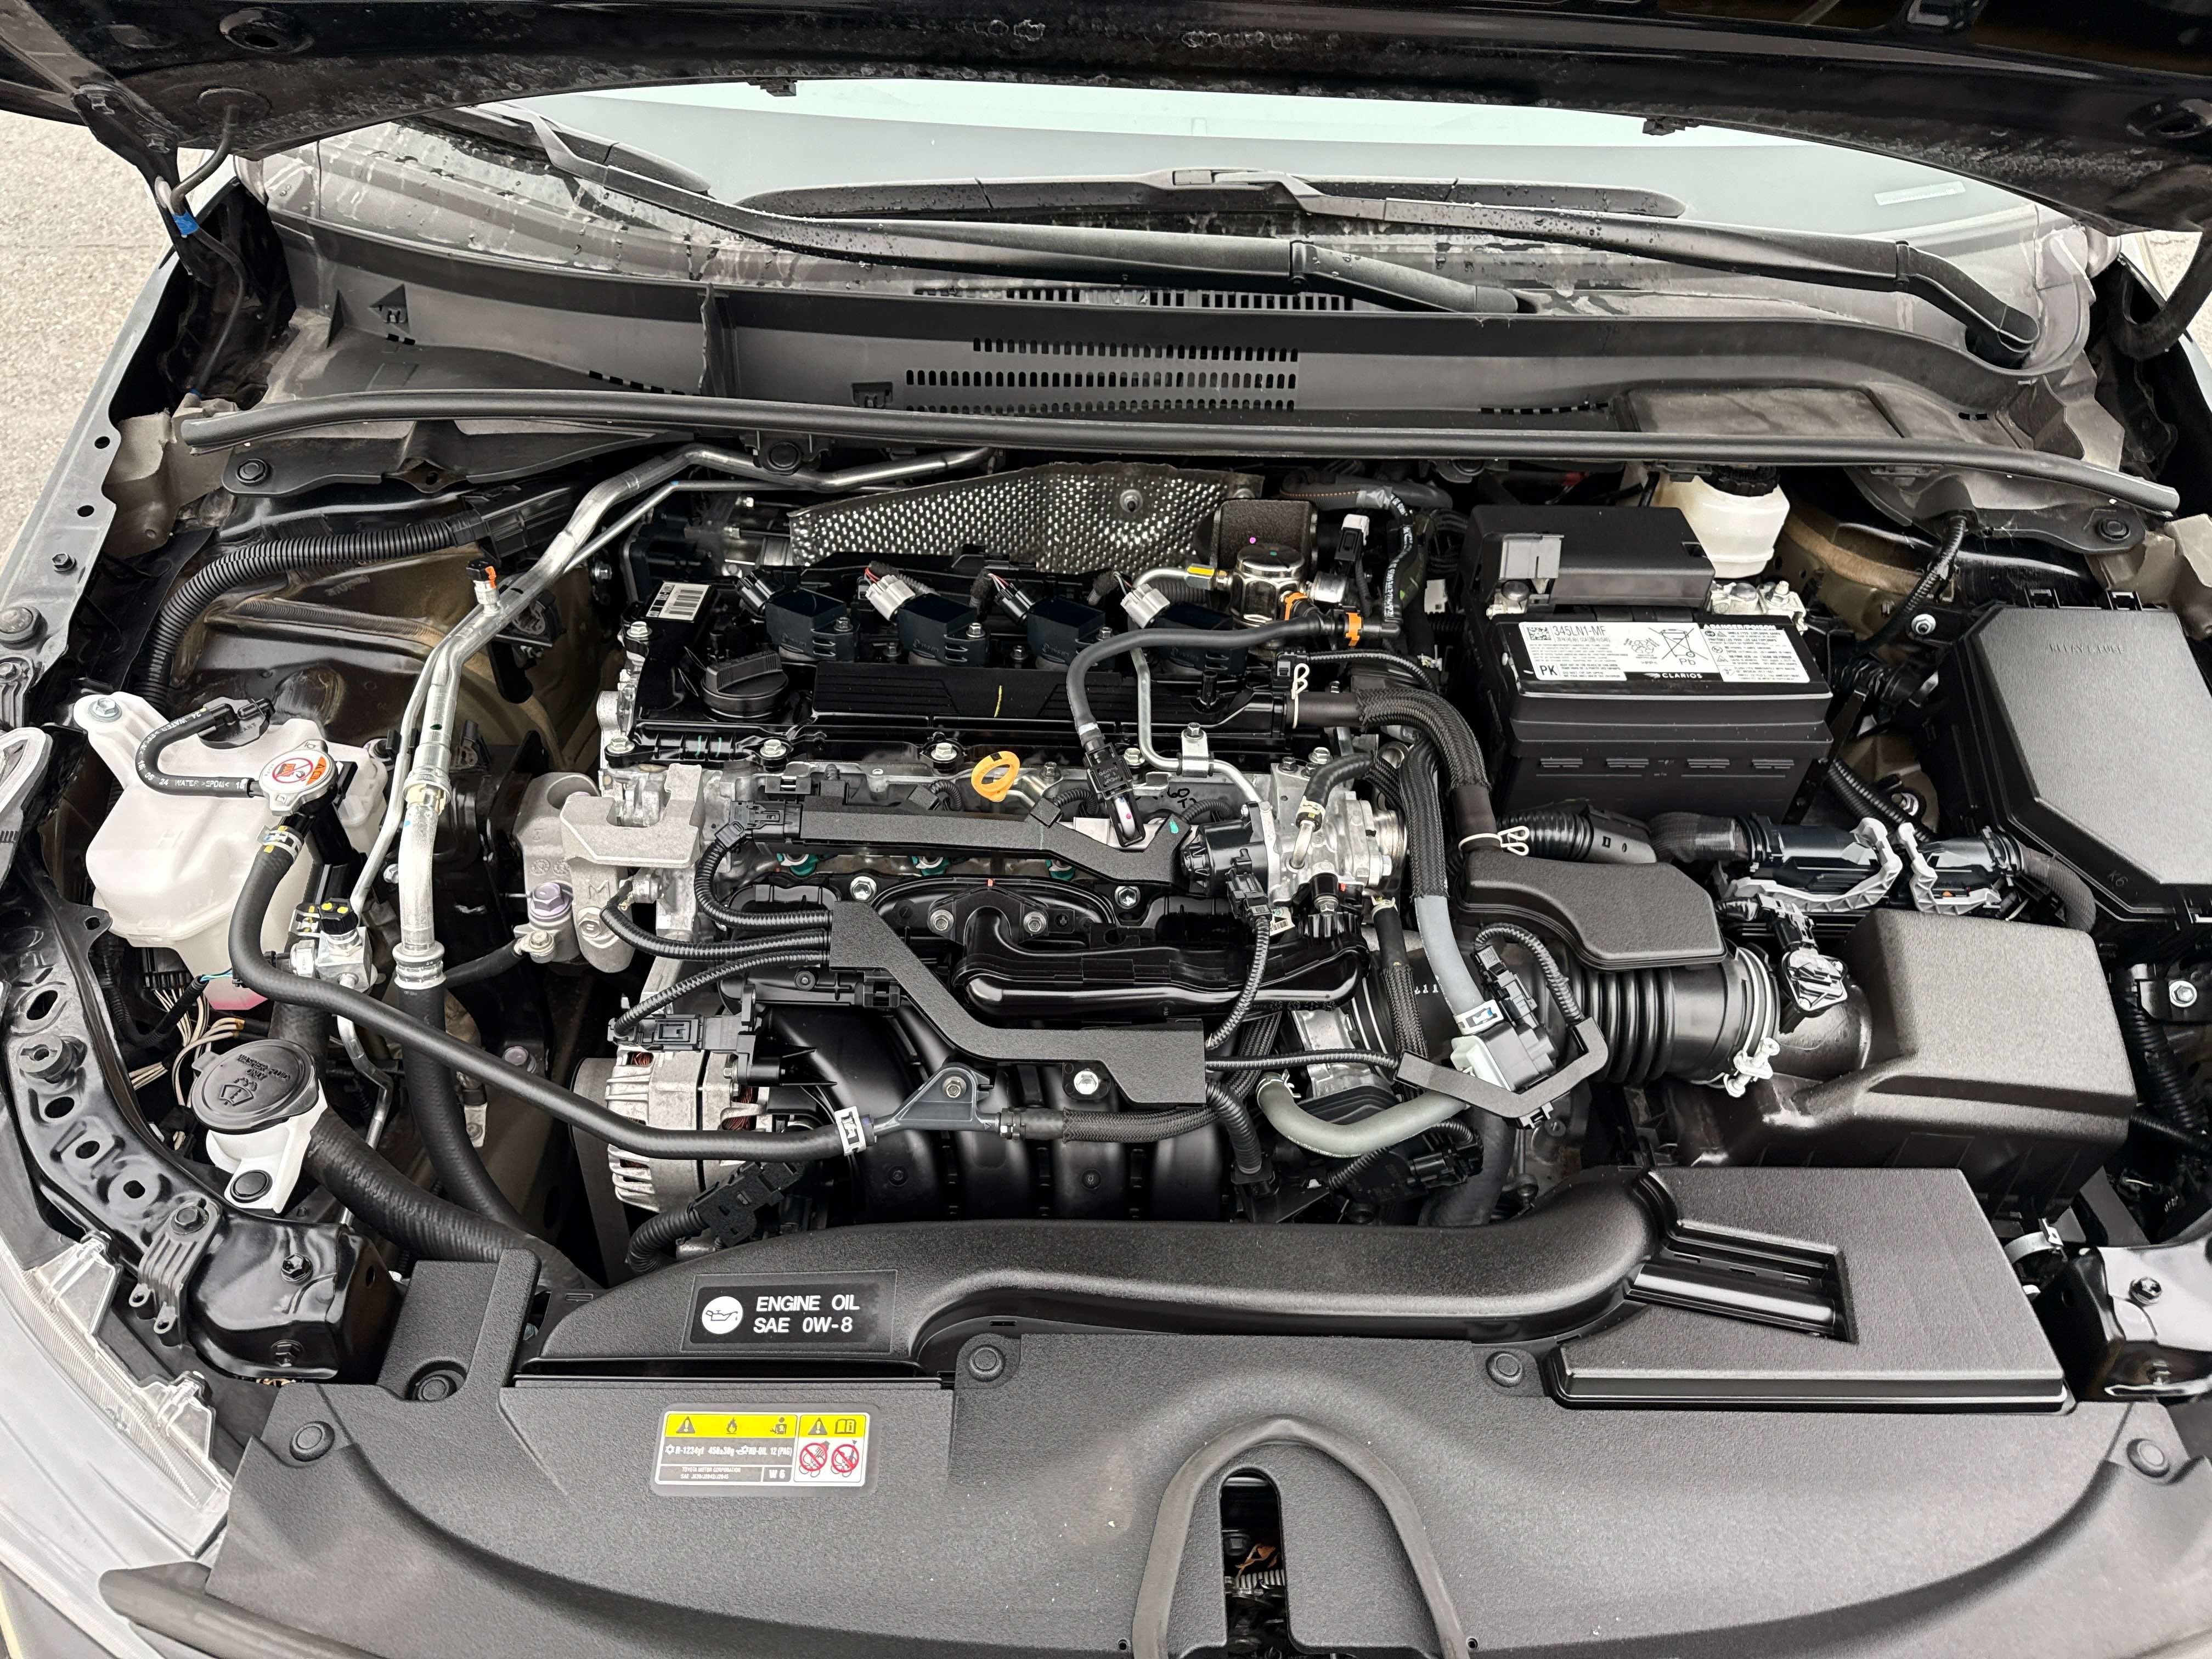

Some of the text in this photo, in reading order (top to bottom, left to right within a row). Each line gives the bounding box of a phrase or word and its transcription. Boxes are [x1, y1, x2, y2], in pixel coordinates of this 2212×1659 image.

[1553, 625, 1606, 636] 345LN1-MF
[1539, 665, 1558, 676] PK
[246, 1069, 268, 1081] ONLY
[756, 1294, 860, 1312] ENGINE OIL
[753, 1317, 853, 1333] SAE 0W-8
